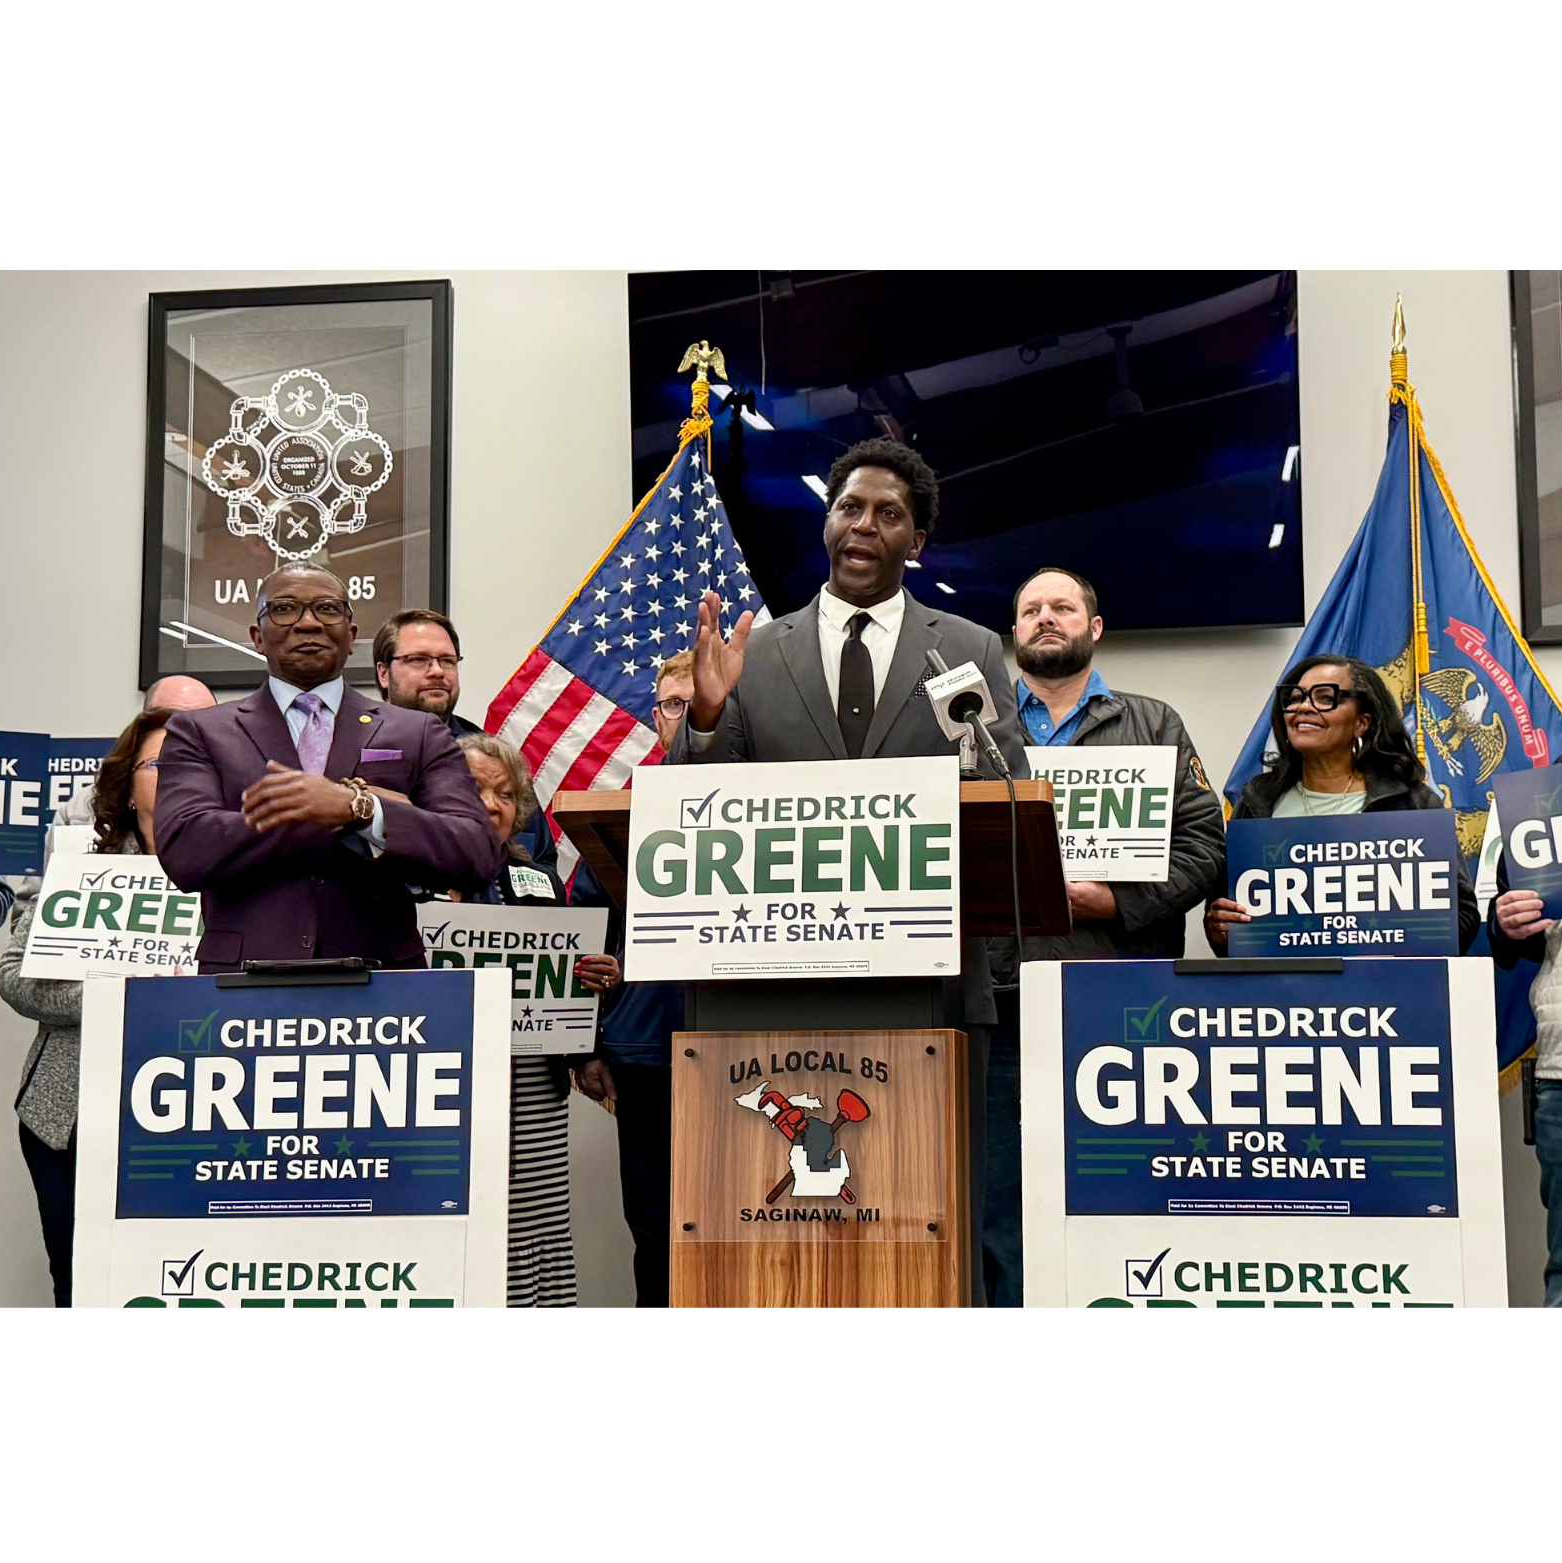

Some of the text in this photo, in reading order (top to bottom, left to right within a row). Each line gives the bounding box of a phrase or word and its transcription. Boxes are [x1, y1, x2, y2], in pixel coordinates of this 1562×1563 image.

[214, 578, 250, 604] UA
[347, 576, 376, 600] 85
[1464, 641, 1534, 745] E PLURIBUS UNUM
[721, 793, 917, 823] CHEDRICK
[635, 823, 952, 898] GREENE
[1290, 838, 1425, 863] CHEDRICK
[1235, 861, 1451, 917] GREENE
[766, 902, 817, 921] FOR
[1323, 916, 1358, 930] FOR
[132, 937, 170, 952] FOR
[450, 929, 581, 950] CHEDRICK
[698, 922, 884, 944] STATE SENATE
[1279, 929, 1405, 946] STATE SENATE
[80, 947, 139, 963] STATE
[220, 1015, 427, 1048] CHEDRICK
[1168, 1006, 1399, 1038] CHEDRICK
[729, 1050, 889, 1084] UA LOCAL 85
[131, 1051, 462, 1133] GREENE
[1075, 1045, 1443, 1127] GREENE
[266, 1134, 320, 1156] FOR
[1227, 1131, 1287, 1153] FOR
[195, 1157, 389, 1181] STATE SENATE
[1151, 1156, 1366, 1180] STATE SENATE
[740, 1207, 880, 1225] SAGINAW, MI
[204, 1261, 418, 1292] CHEDRICK
[1174, 1261, 1411, 1296] CHEDRICK
